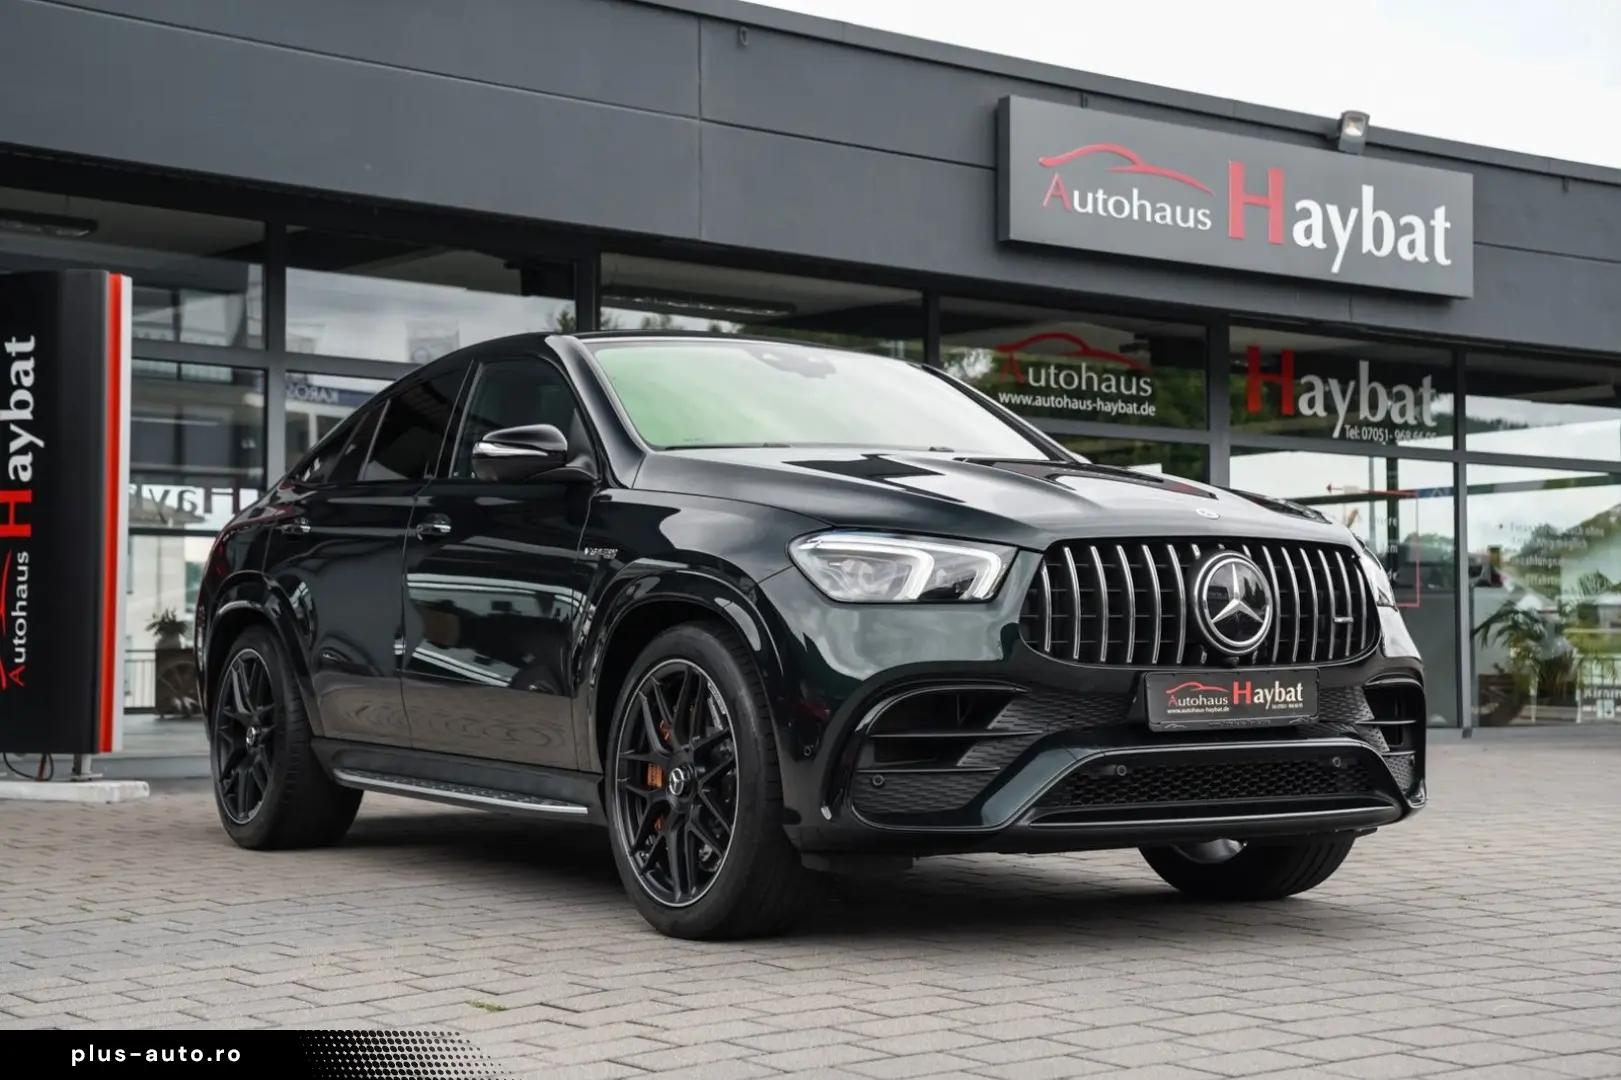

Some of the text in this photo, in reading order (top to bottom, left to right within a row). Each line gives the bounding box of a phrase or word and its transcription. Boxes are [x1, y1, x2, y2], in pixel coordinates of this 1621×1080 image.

[1042, 159, 1452, 274] Autohaus Haybat
[998, 345, 1438, 439] Autohaus Haybat
[998, 391, 1156, 417] www.autohaus-haybat.de
[0, 335, 45, 687] Autohaus Haybat
[1167, 680, 1304, 710] Autohaus Haybat
